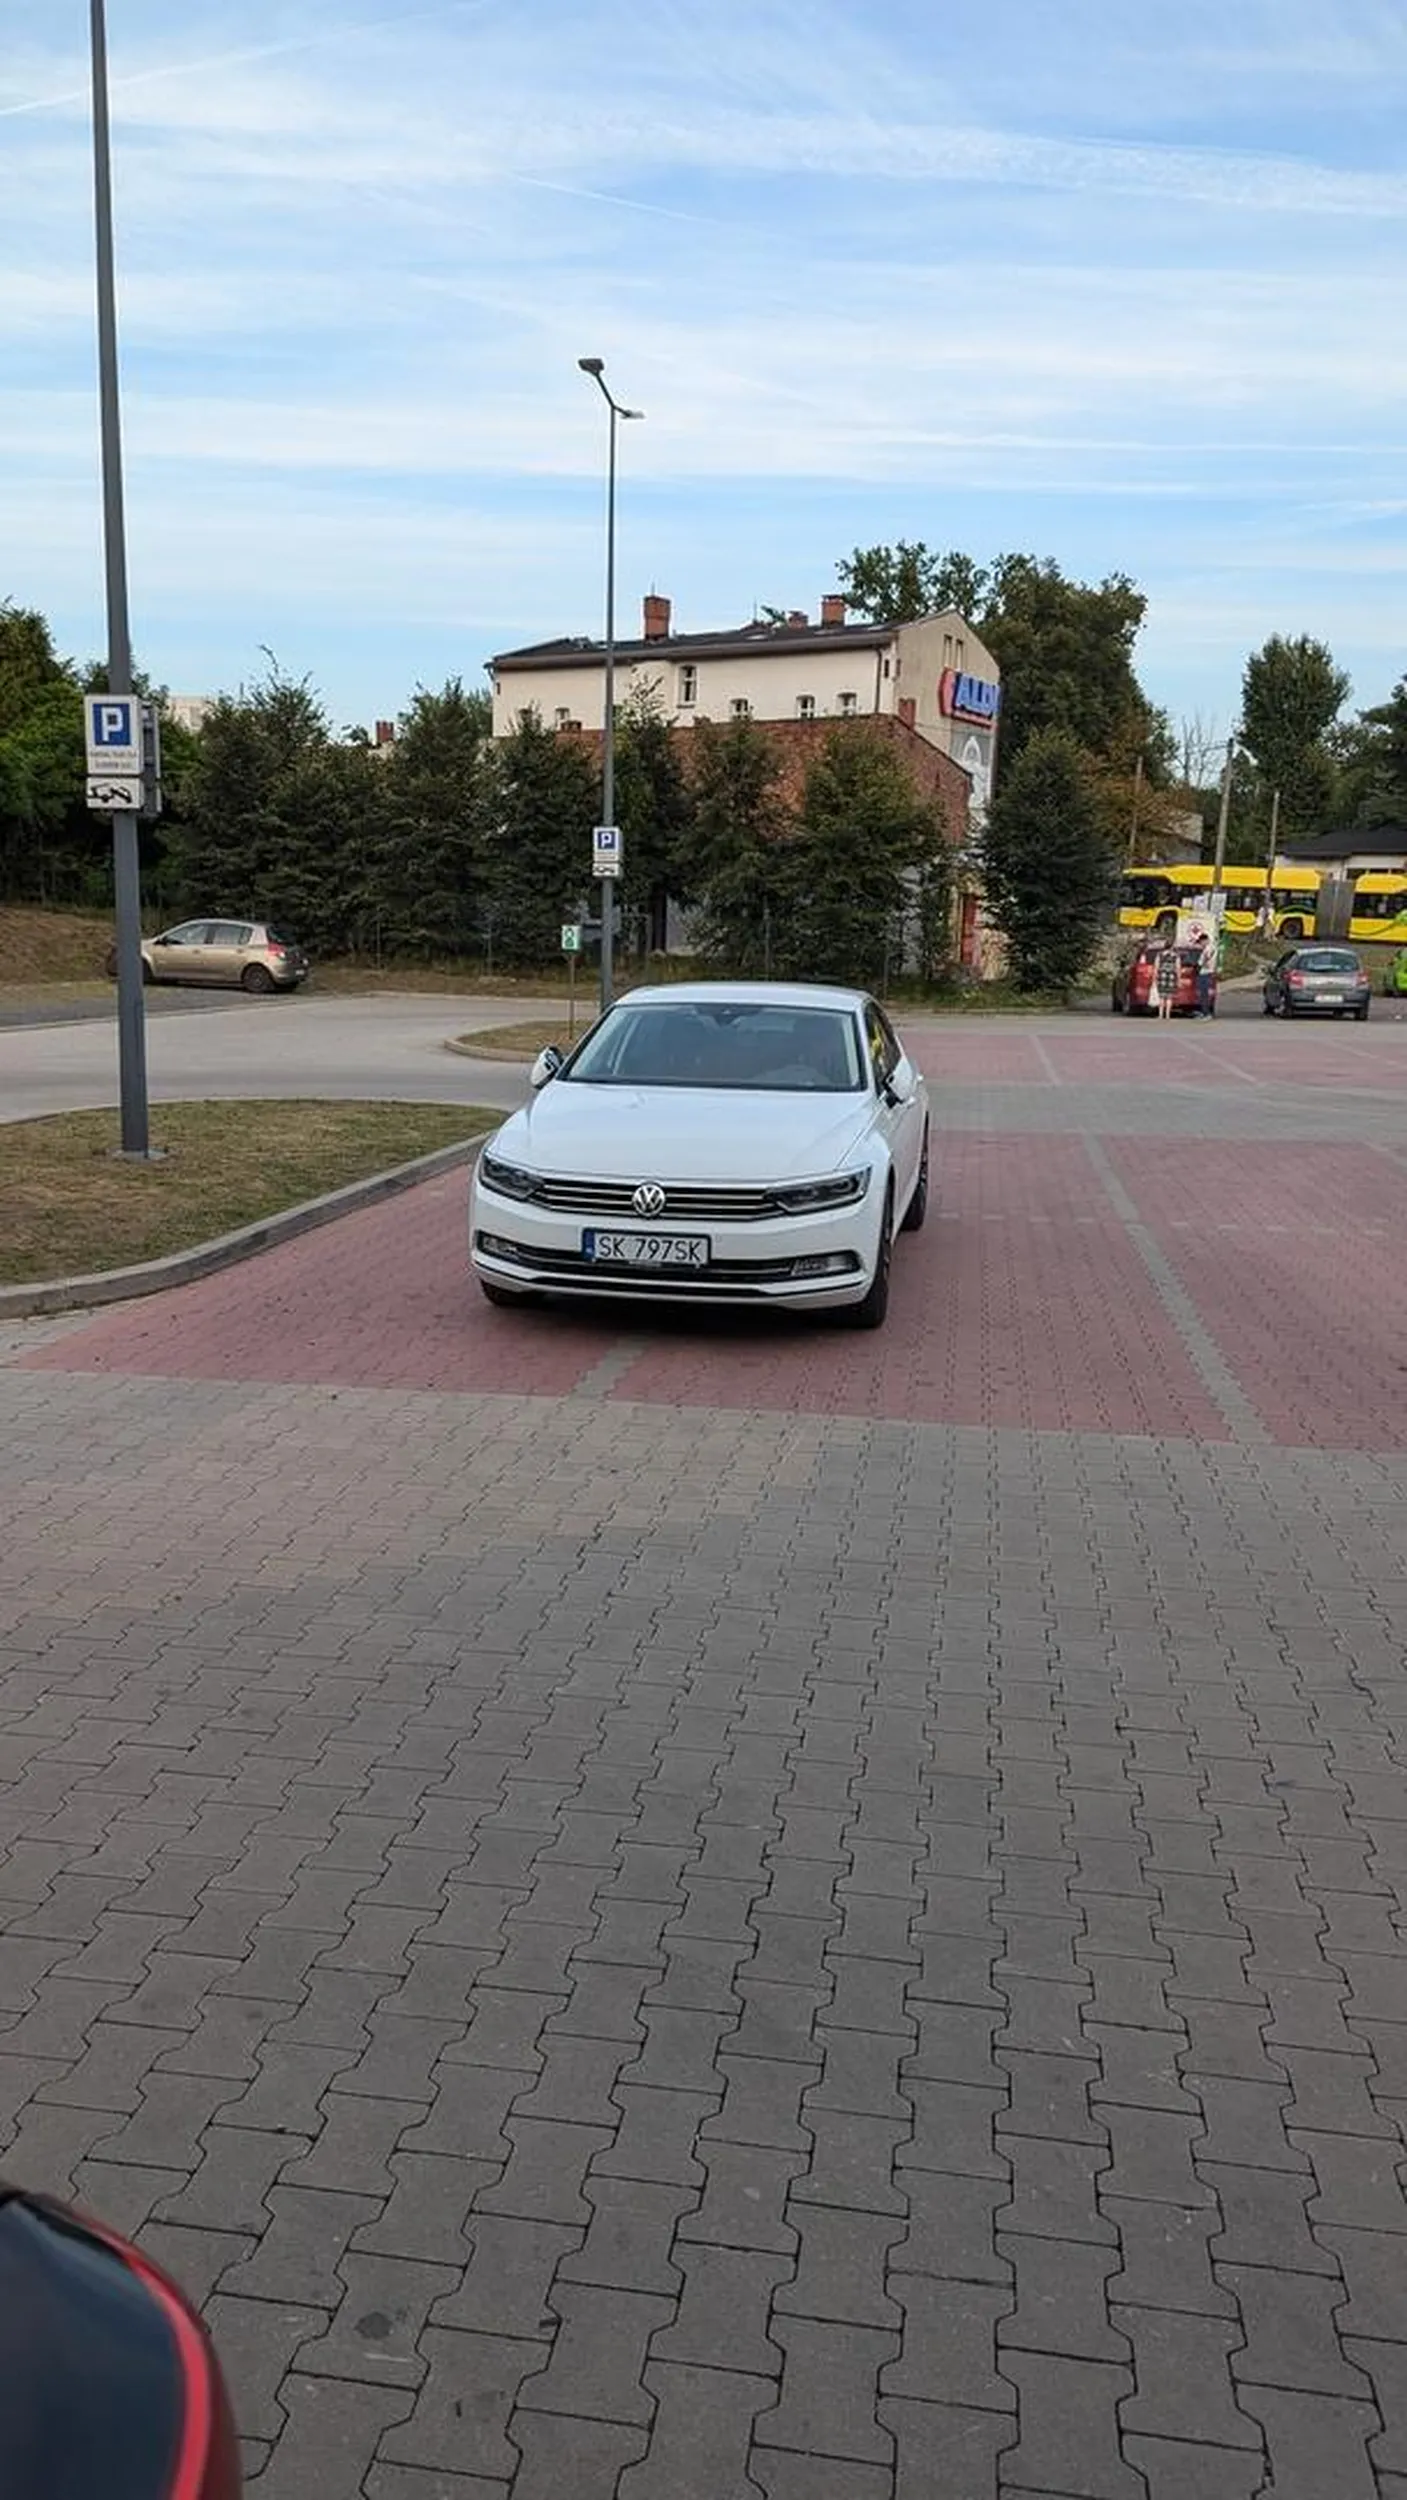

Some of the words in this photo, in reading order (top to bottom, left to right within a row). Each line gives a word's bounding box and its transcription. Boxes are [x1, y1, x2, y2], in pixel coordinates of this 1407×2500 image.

[101, 706, 123, 742] P
[601, 832, 612, 848] P
[599, 1236, 626, 1258] SK
[634, 1238, 701, 1262] 797SK
